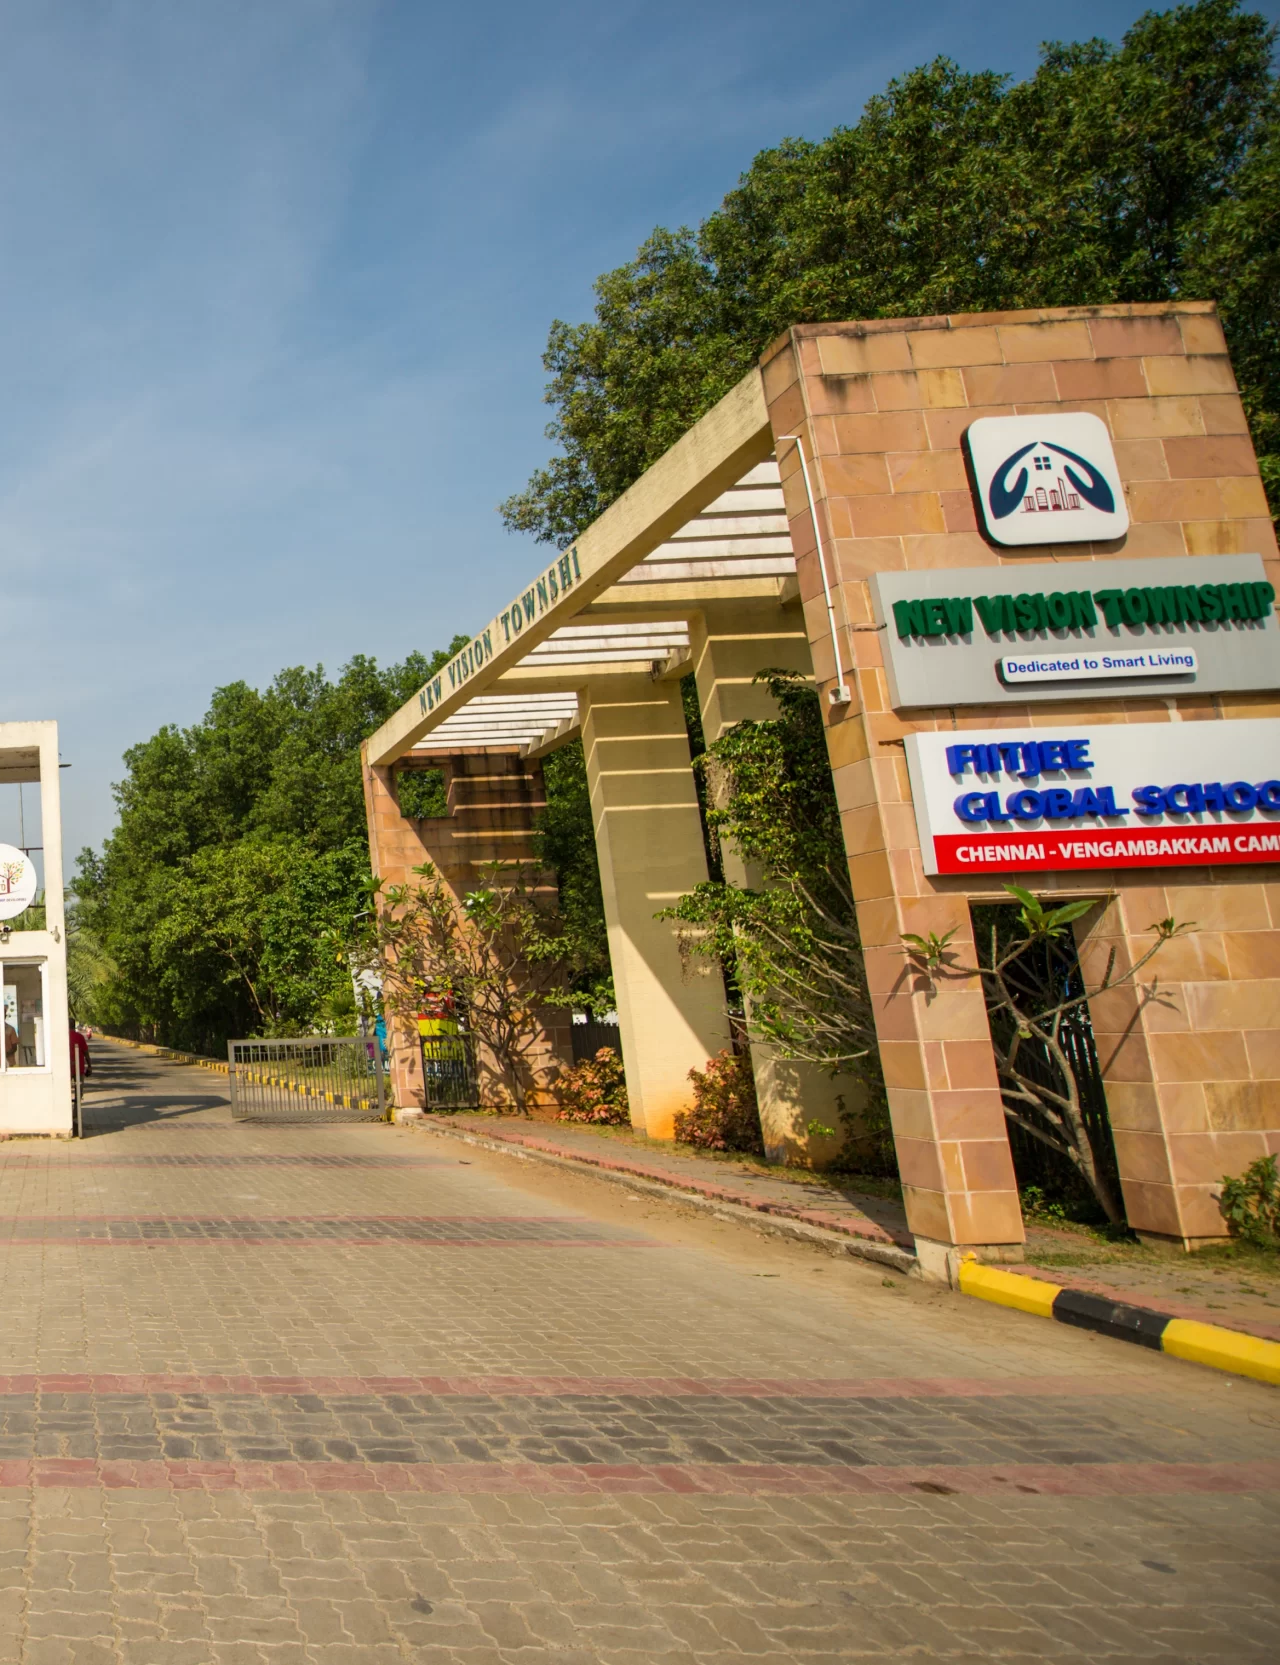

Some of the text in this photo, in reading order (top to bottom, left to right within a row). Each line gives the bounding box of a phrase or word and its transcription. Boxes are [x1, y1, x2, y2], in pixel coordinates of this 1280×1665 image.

[892, 581, 1276, 639] NEW VISION TOWNSHIP
[418, 546, 582, 718] NEW VISION TOWNSHI
[1007, 654, 1195, 674] Dedicated to Smart Living
[945, 739, 1095, 778] FIITJEE
[953, 780, 1280, 822] GLOBAL SCHOO
[956, 844, 1046, 863] CHENNAI
[1058, 837, 1232, 859] VENGAMBAKKAM
[1233, 834, 1280, 852] CAM
